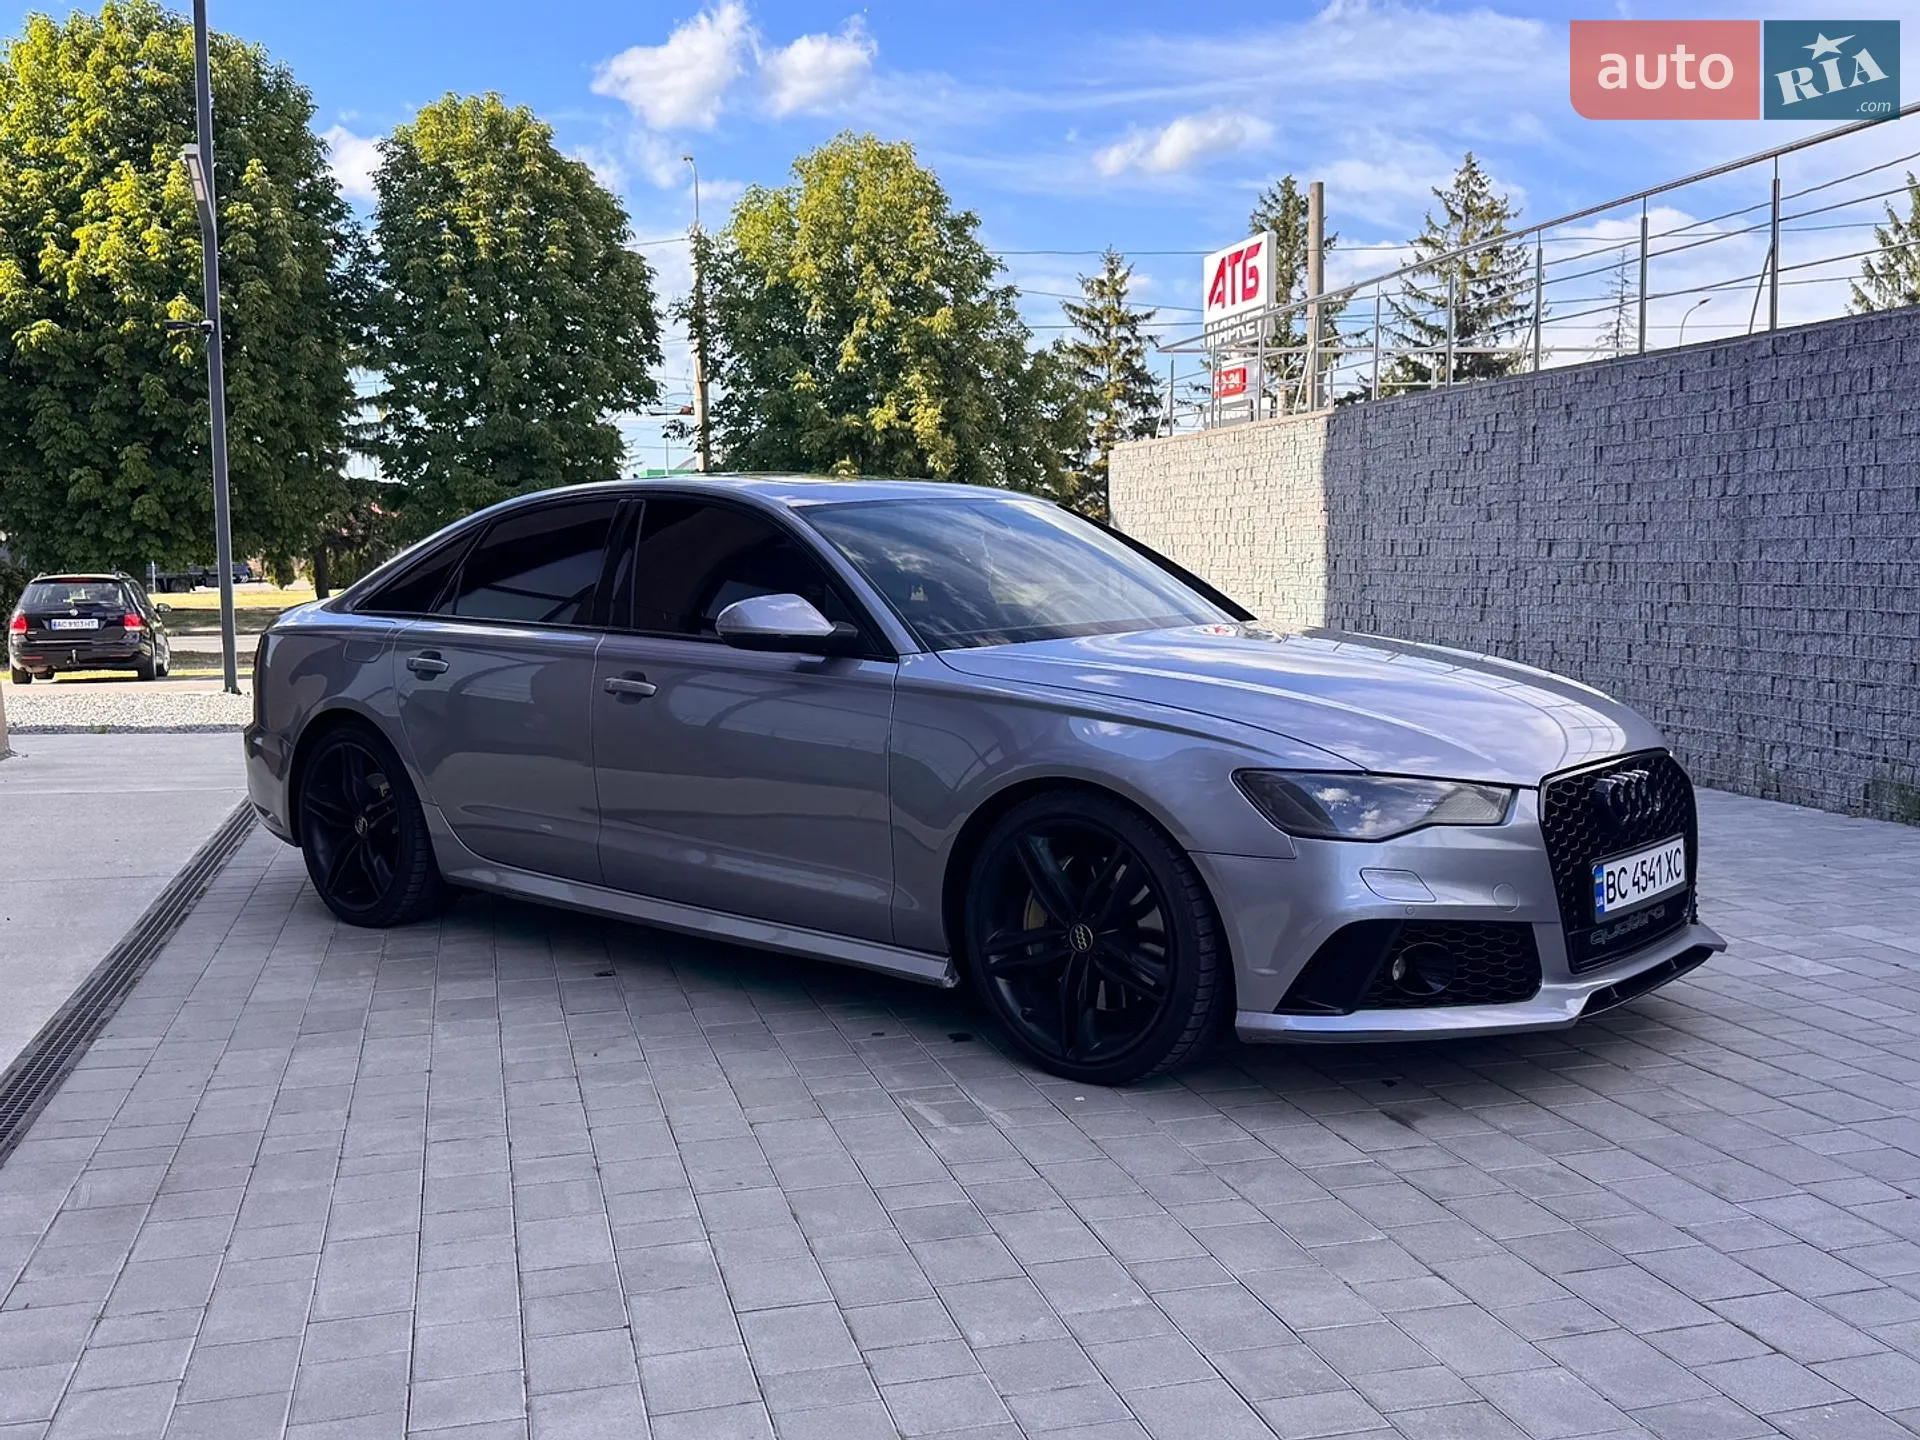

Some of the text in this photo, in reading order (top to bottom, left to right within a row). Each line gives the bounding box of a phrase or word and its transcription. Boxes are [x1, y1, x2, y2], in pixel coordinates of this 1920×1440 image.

[1208, 241, 1263, 312] АТБ
[1606, 847, 1682, 904] BC 4541 XC
[1590, 904, 1666, 945] quattro
